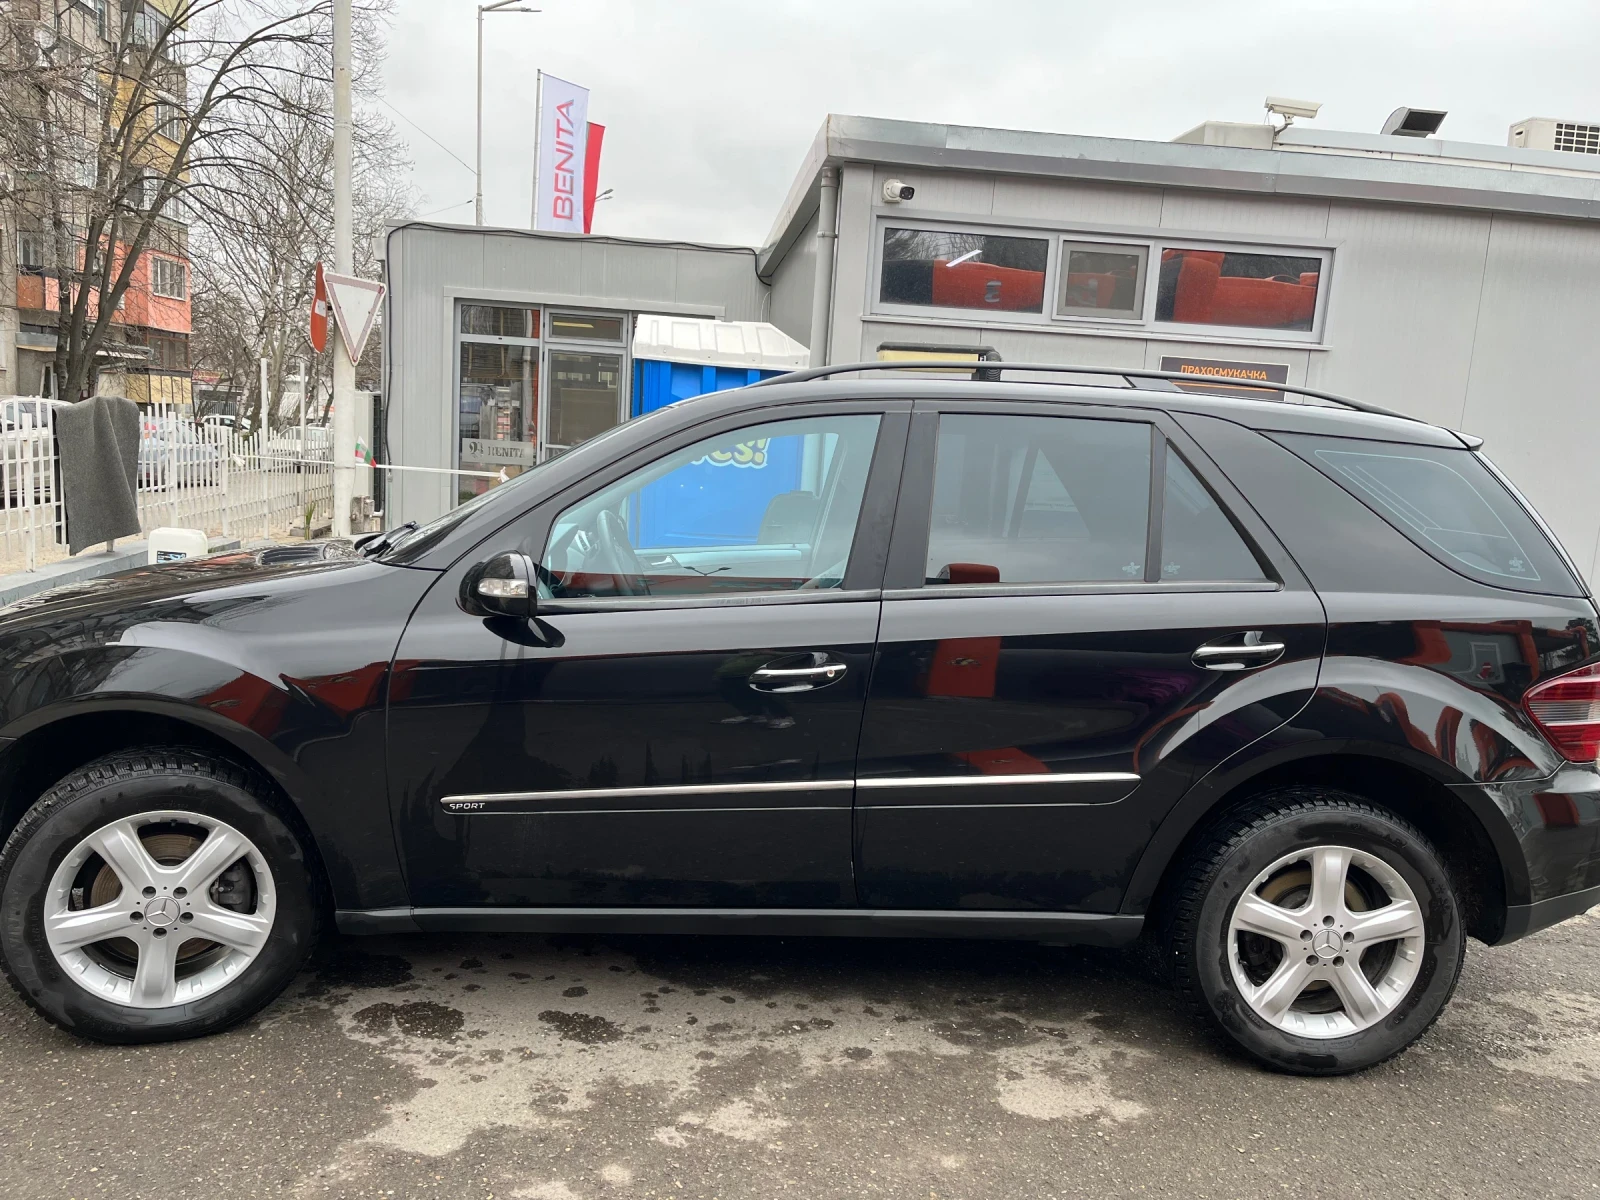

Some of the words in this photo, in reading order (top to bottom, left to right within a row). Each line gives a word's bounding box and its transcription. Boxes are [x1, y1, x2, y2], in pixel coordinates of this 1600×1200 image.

[552, 98, 575, 221] BENITA
[1180, 364, 1267, 380] ПРАХОСМУКАЧКА
[449, 802, 486, 810] SPORT
